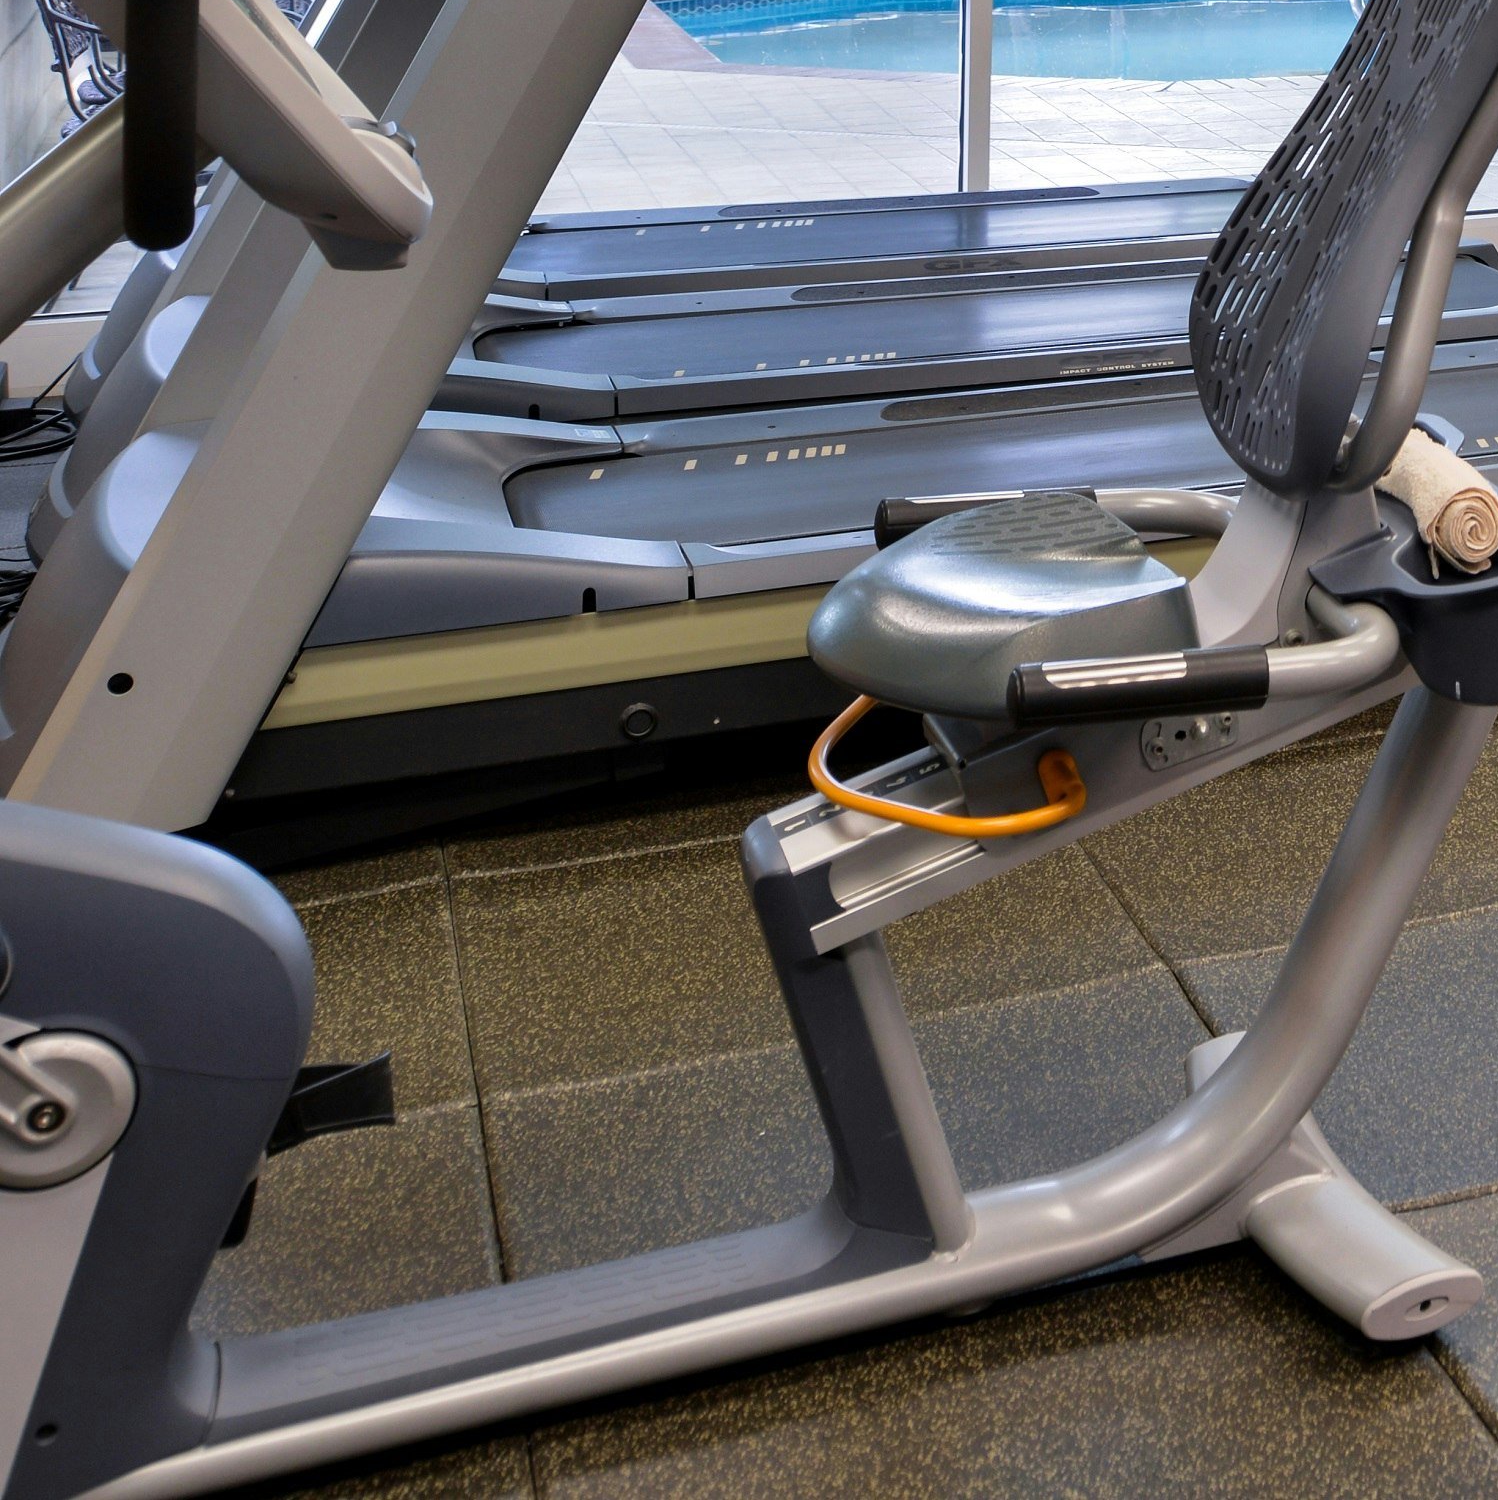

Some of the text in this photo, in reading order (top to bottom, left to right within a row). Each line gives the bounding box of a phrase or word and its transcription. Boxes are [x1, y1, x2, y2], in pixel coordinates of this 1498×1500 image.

[1060, 360, 1175, 376] IMPACT CONTROL SYSTEM
